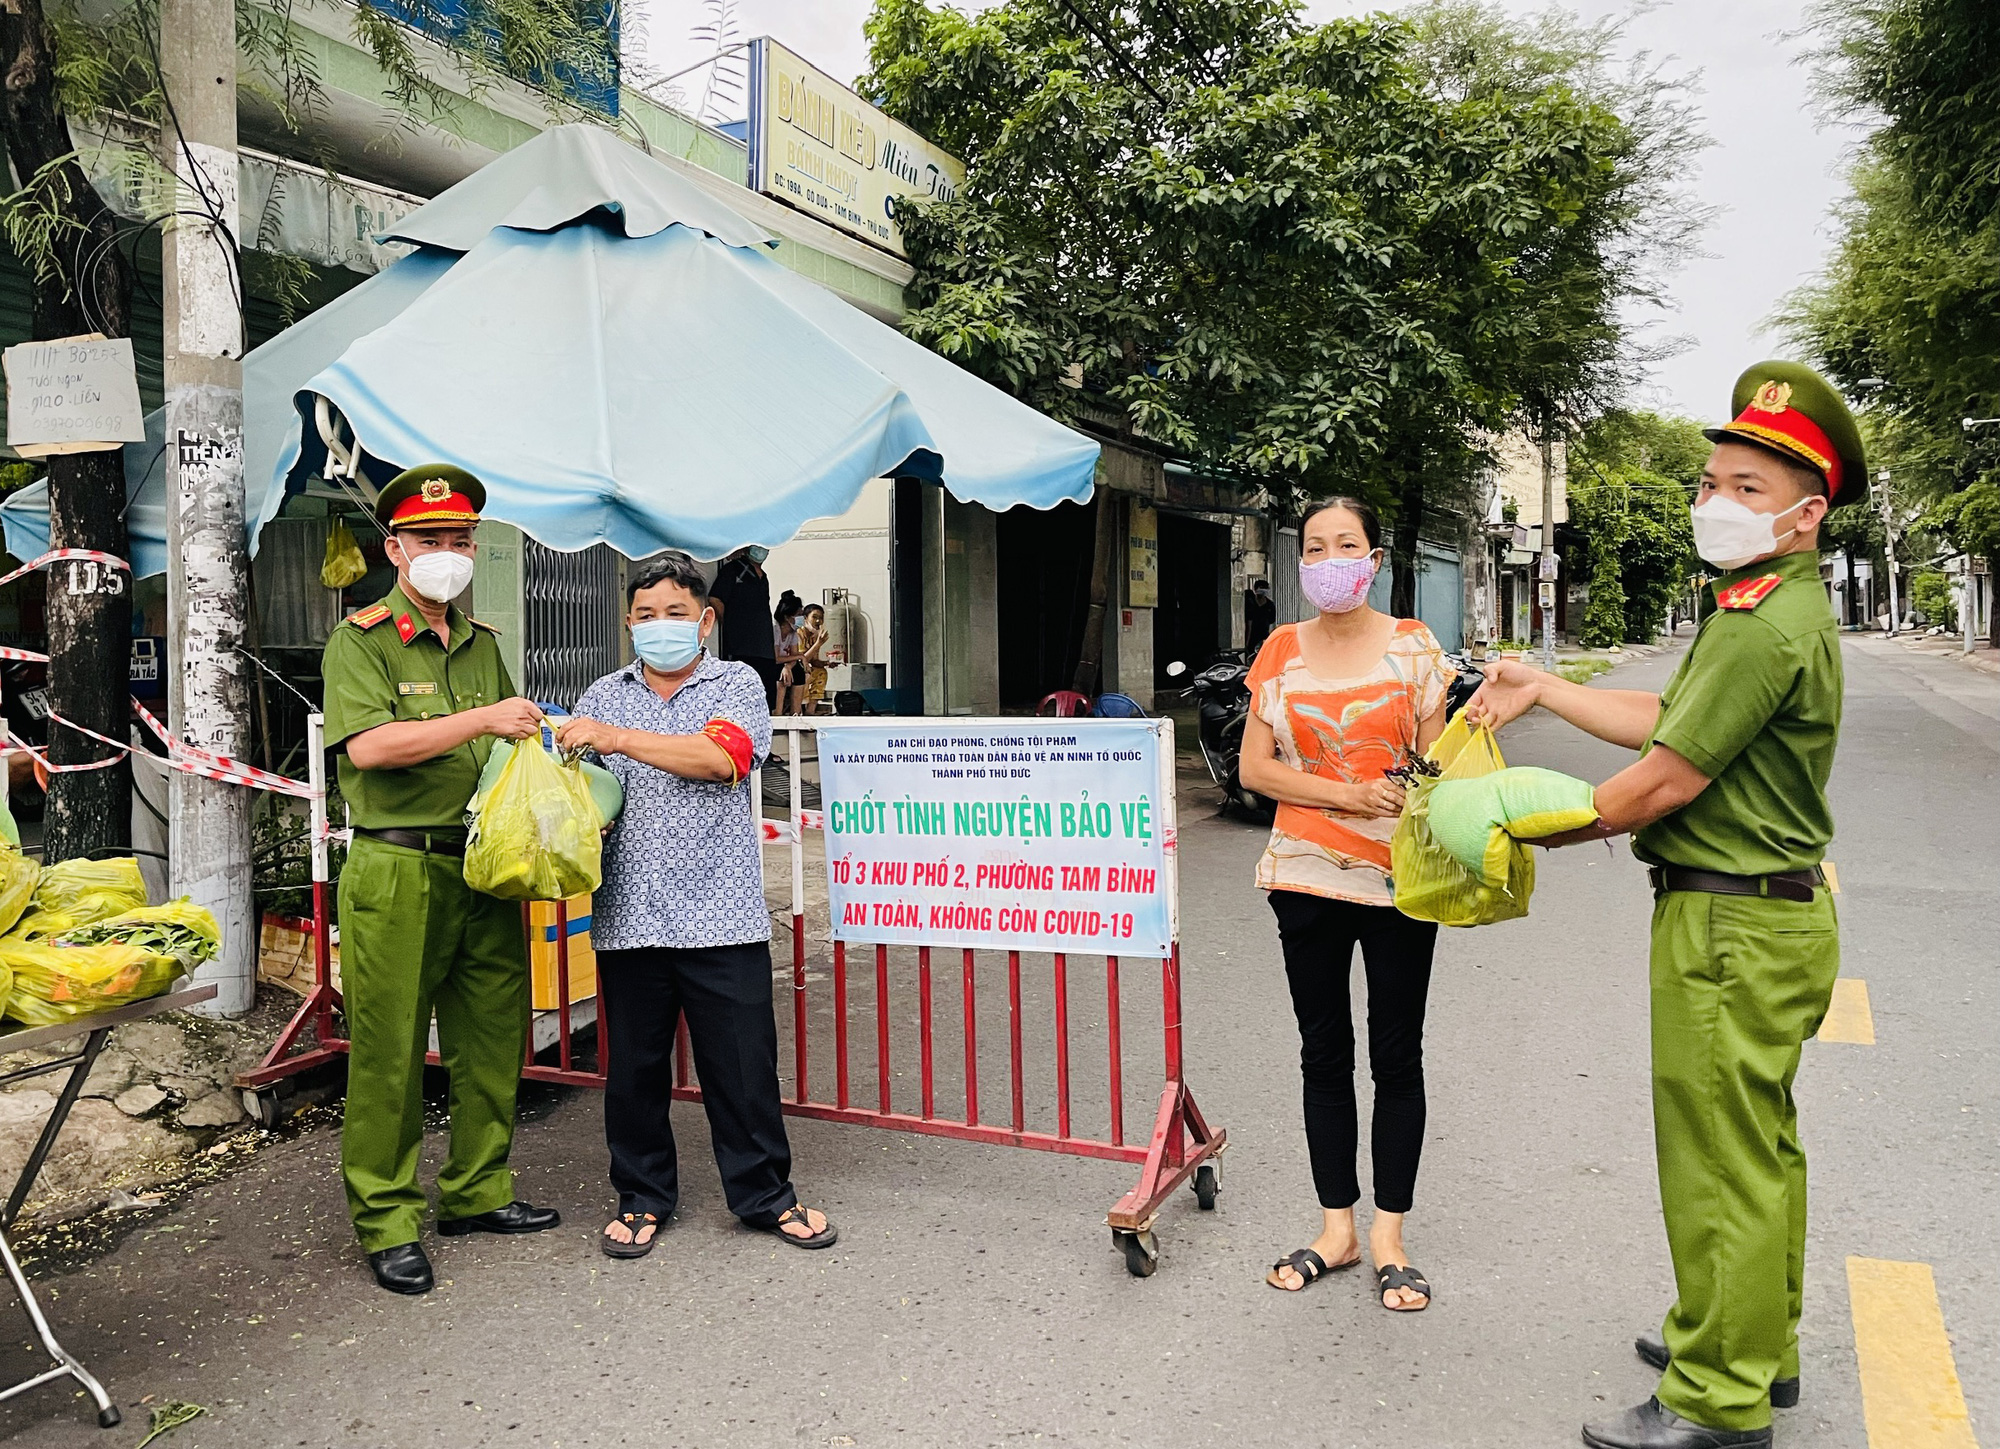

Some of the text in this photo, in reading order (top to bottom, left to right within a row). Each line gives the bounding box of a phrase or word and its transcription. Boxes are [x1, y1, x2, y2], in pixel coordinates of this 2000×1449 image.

[778, 70, 876, 171] BÁNH XÈO
[786, 138, 823, 183] BÁNH
[878, 139, 918, 187] Miền
[833, 752, 845, 763] VÀ
[848, 752, 865, 763] XÂY
[868, 753, 893, 765] DỰNG
[896, 753, 929, 763] PHONG
[932, 752, 956, 763] TRÀO
[959, 751, 984, 763] TOÀN
[987, 751, 1008, 762] DÂN
[1011, 750, 1031, 762] BẢO
[1034, 750, 1047, 764] VỆ
[1049, 752, 1064, 762] AN
[1067, 751, 1093, 762] NINH
[1112, 748, 1142, 762] QUỐC
[888, 734, 1077, 749] BAN CHỈ ĐẠO PHÒNG, CHỐNG TỘI PHẠM
[932, 766, 1031, 778] THÀNH PHỐ THỦ ĐỨC
[830, 789, 1152, 847] CHỐT TÌNH NGUYỆN BẢO VỆ
[833, 852, 1156, 894] TỔ 3 KHU PHỐ 2, PHƯỜNG TAM BÌNH
[843, 899, 1134, 939] AN TOÀN, KHÔNG CÒN COVID-19
